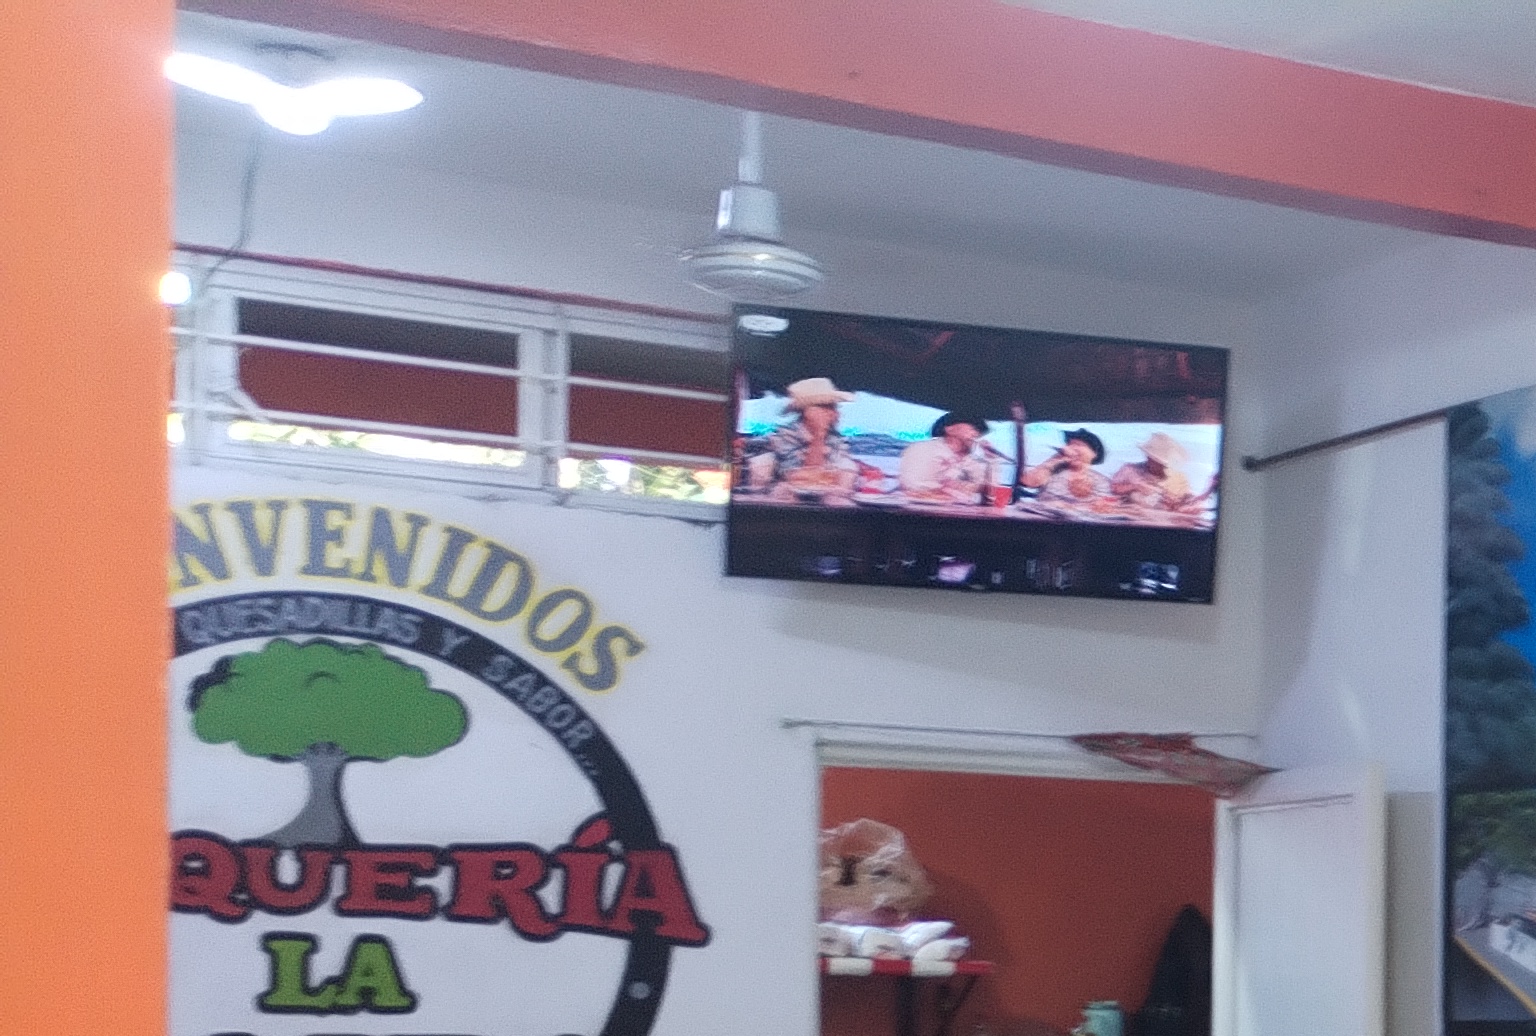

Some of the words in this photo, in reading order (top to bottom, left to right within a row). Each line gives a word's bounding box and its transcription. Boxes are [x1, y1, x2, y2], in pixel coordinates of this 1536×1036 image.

[170, 497, 647, 693] NVENIDOS
[441, 628, 471, 656] Y
[170, 814, 711, 947] QUERÍA
[255, 932, 419, 1015] LA
